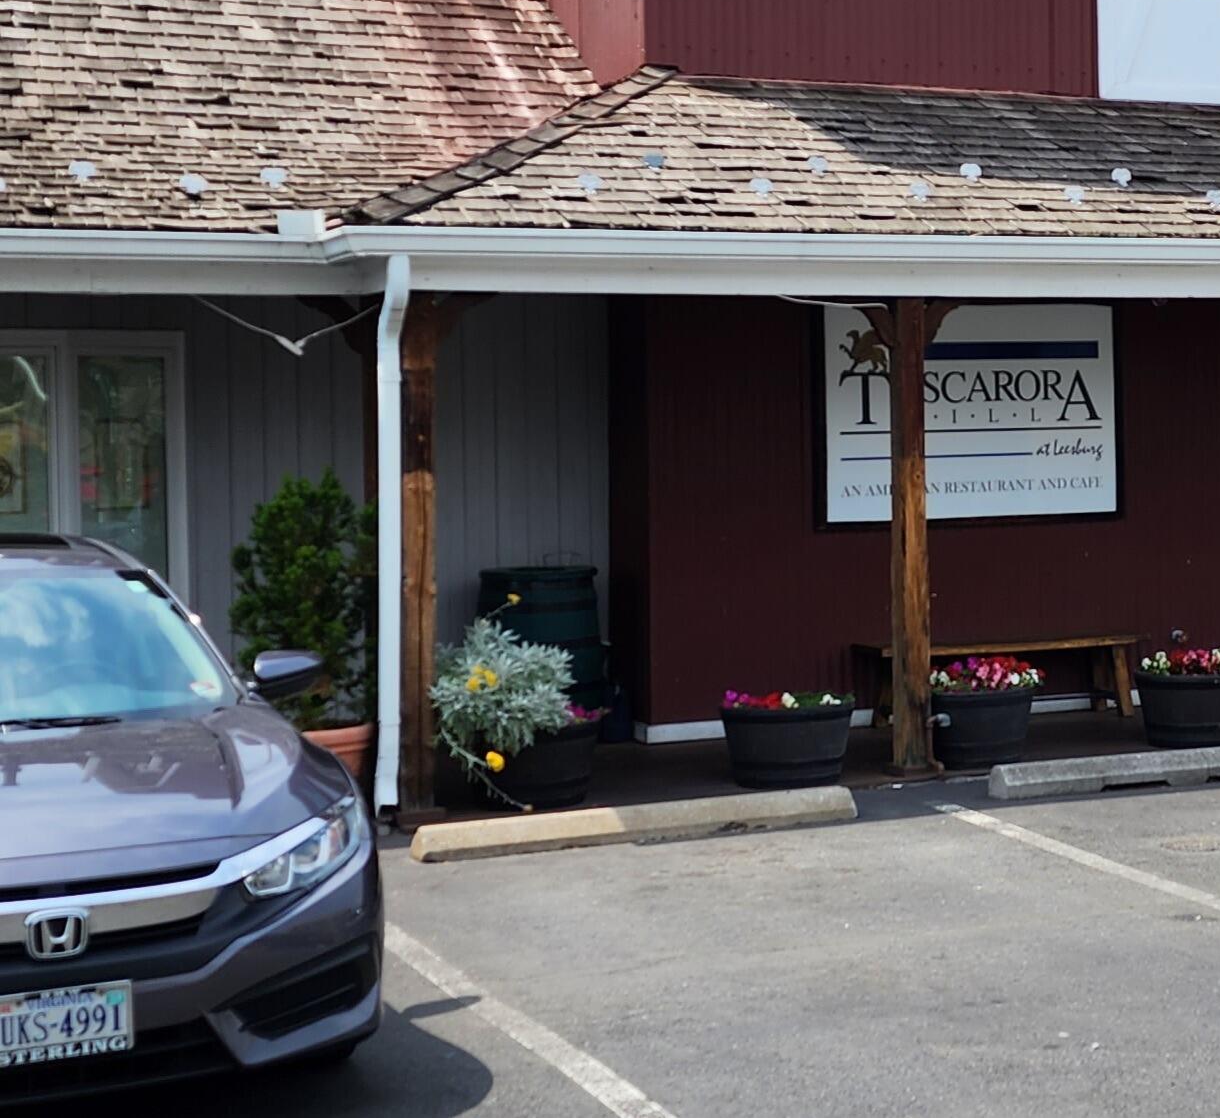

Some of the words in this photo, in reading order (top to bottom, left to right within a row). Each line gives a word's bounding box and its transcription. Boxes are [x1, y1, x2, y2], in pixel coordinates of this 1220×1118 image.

[839, 369, 1103, 426] TSCARORA
[1036, 444, 1051, 456] at
[1053, 438, 1104, 461] Leesburg
[841, 485, 863, 498] AN
[943, 478, 1035, 494] RESTAURANT
[1037, 477, 1068, 491] AND
[1, 1003, 121, 1046] UKS-4991
[0, 1035, 127, 1069] STERLING
